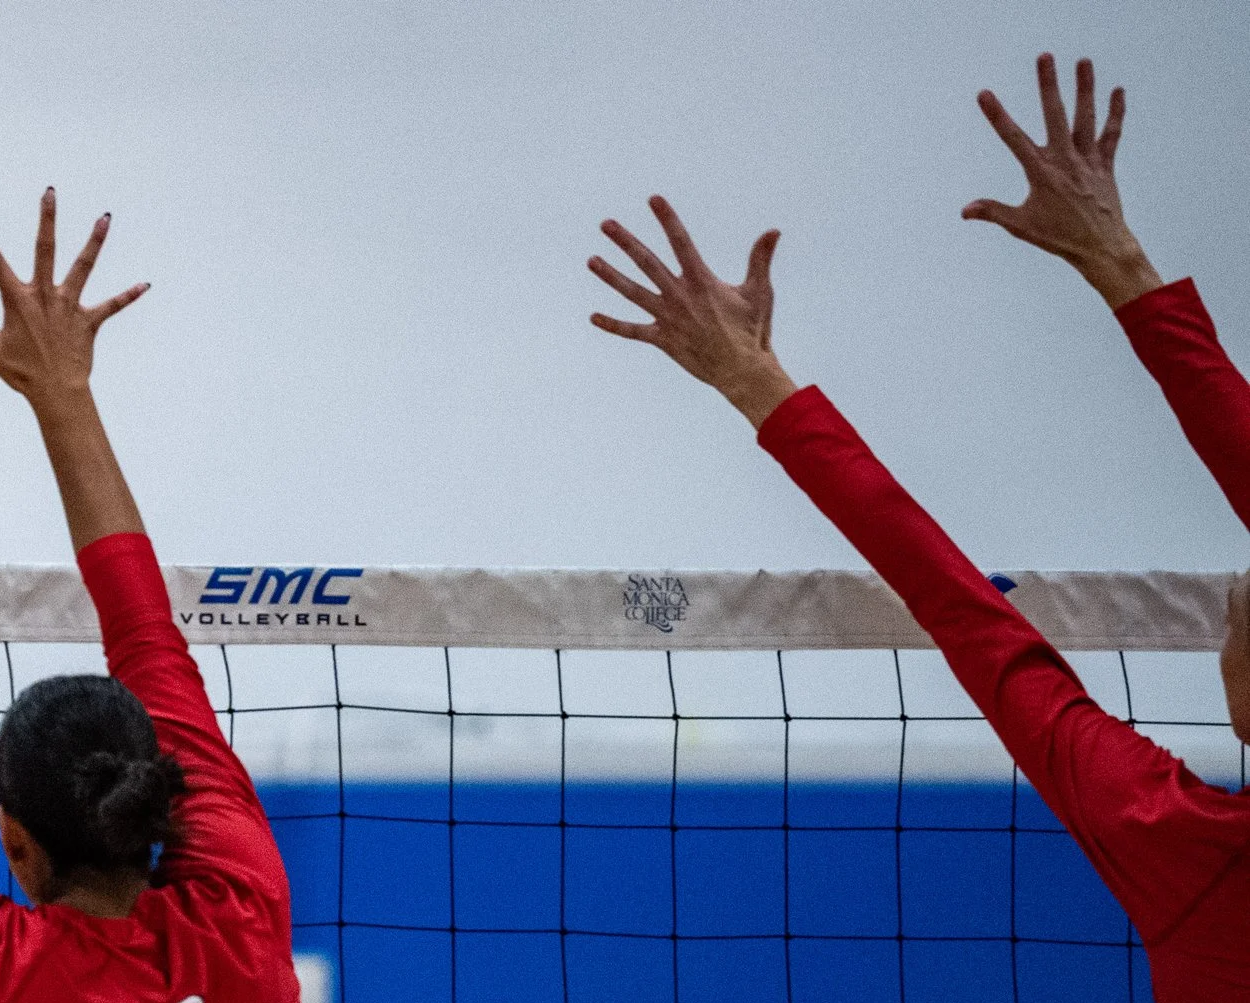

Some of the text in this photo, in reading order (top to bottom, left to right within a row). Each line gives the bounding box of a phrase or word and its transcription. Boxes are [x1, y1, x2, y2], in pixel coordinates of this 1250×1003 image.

[198, 566, 364, 605] SMC
[627, 573, 686, 592] SANTA
[621, 591, 691, 607] MONICA
[179, 612, 368, 627] VOLLEYBALL
